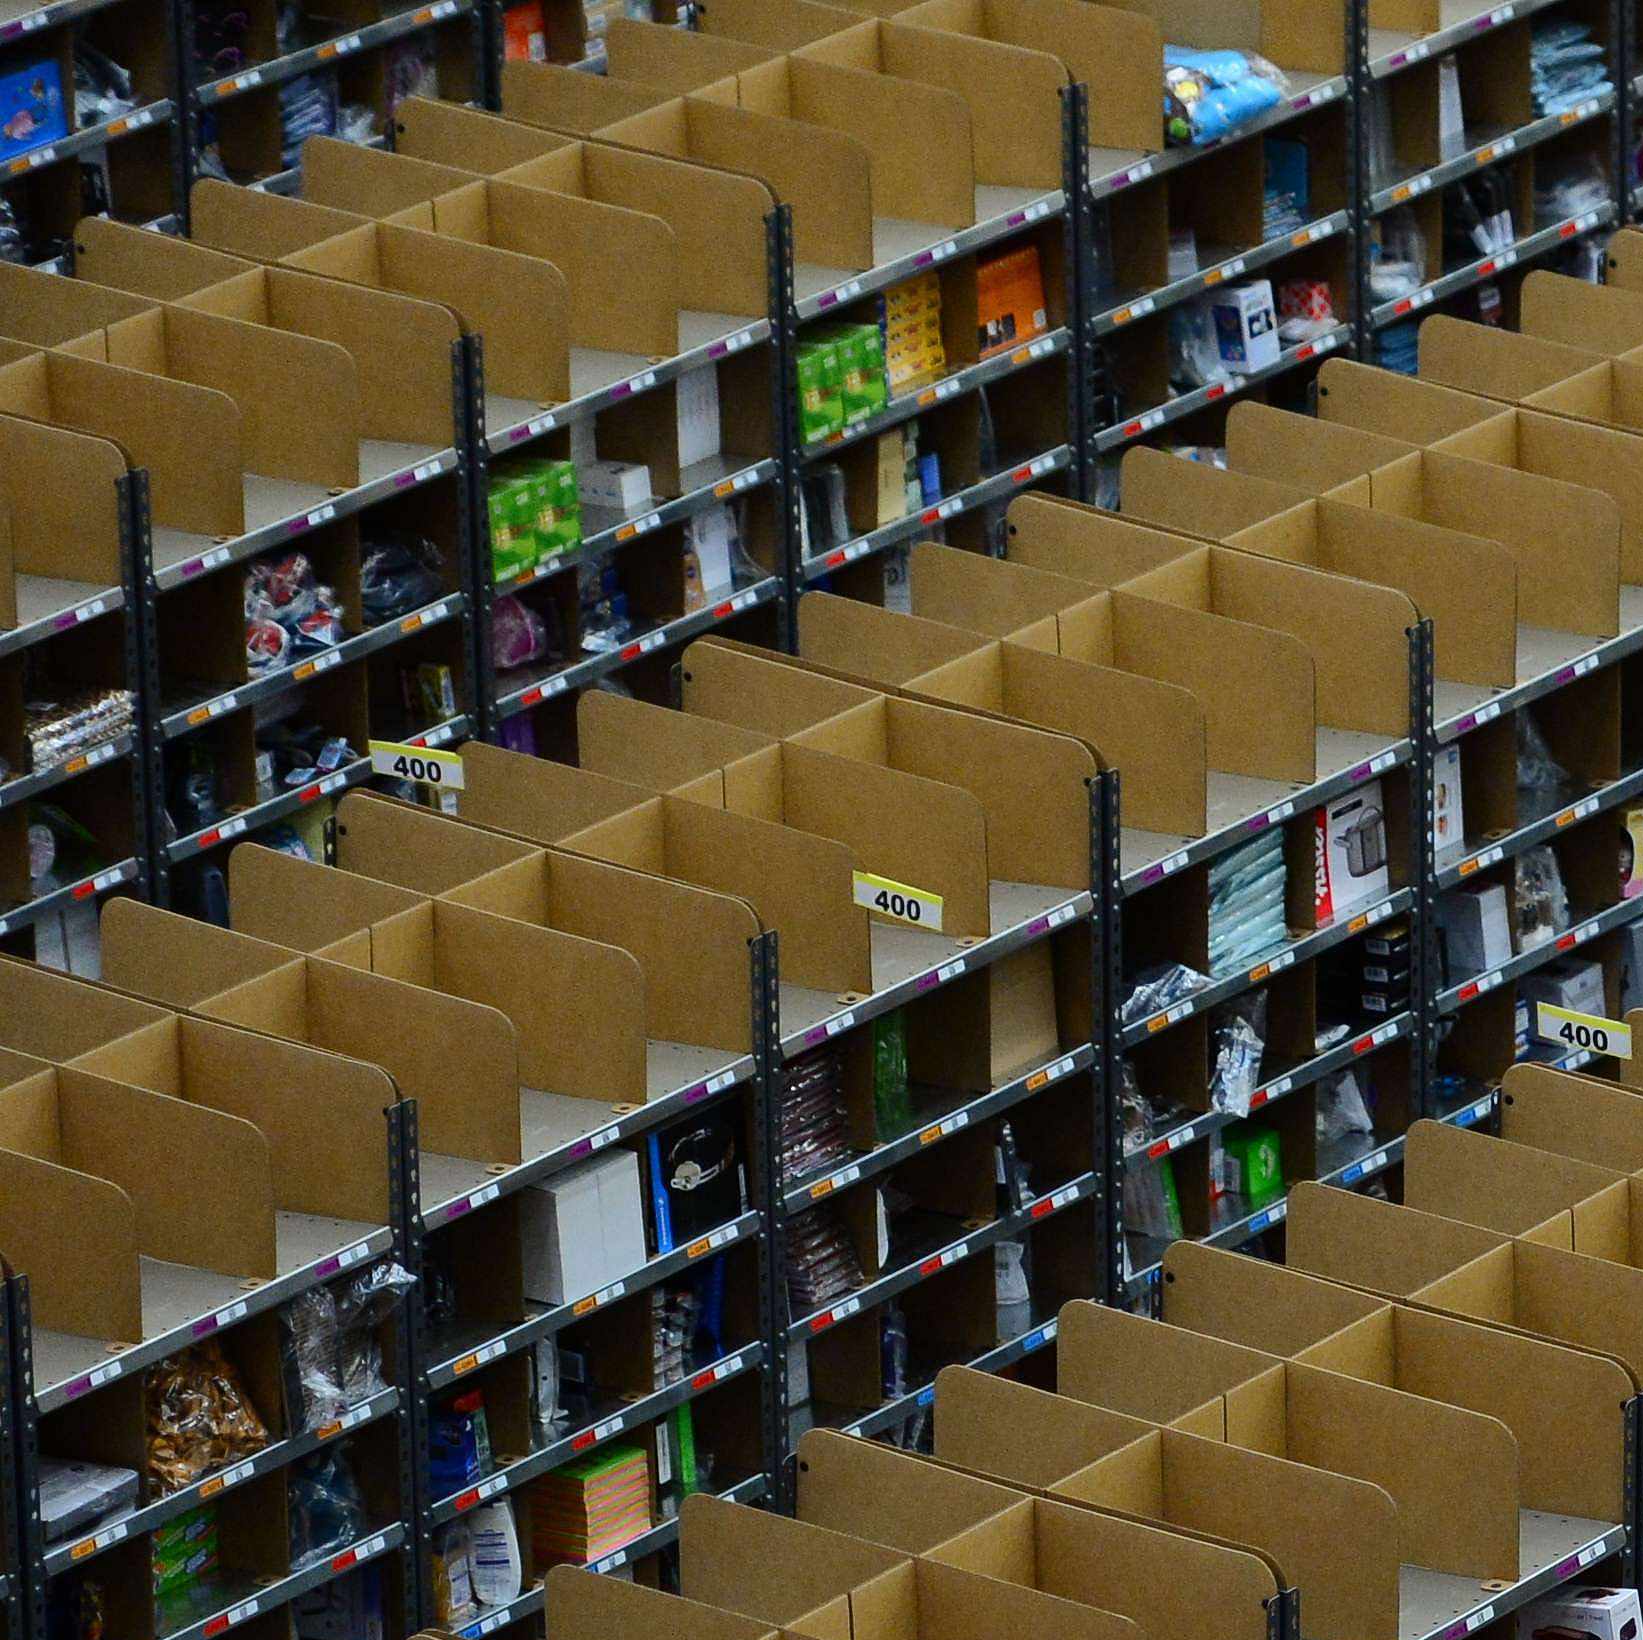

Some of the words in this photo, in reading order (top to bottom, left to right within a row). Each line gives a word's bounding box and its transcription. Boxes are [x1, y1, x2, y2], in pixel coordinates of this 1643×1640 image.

[394, 756, 441, 782] 400
[875, 891, 920, 920] 400
[1560, 1023, 1608, 1051] 400
